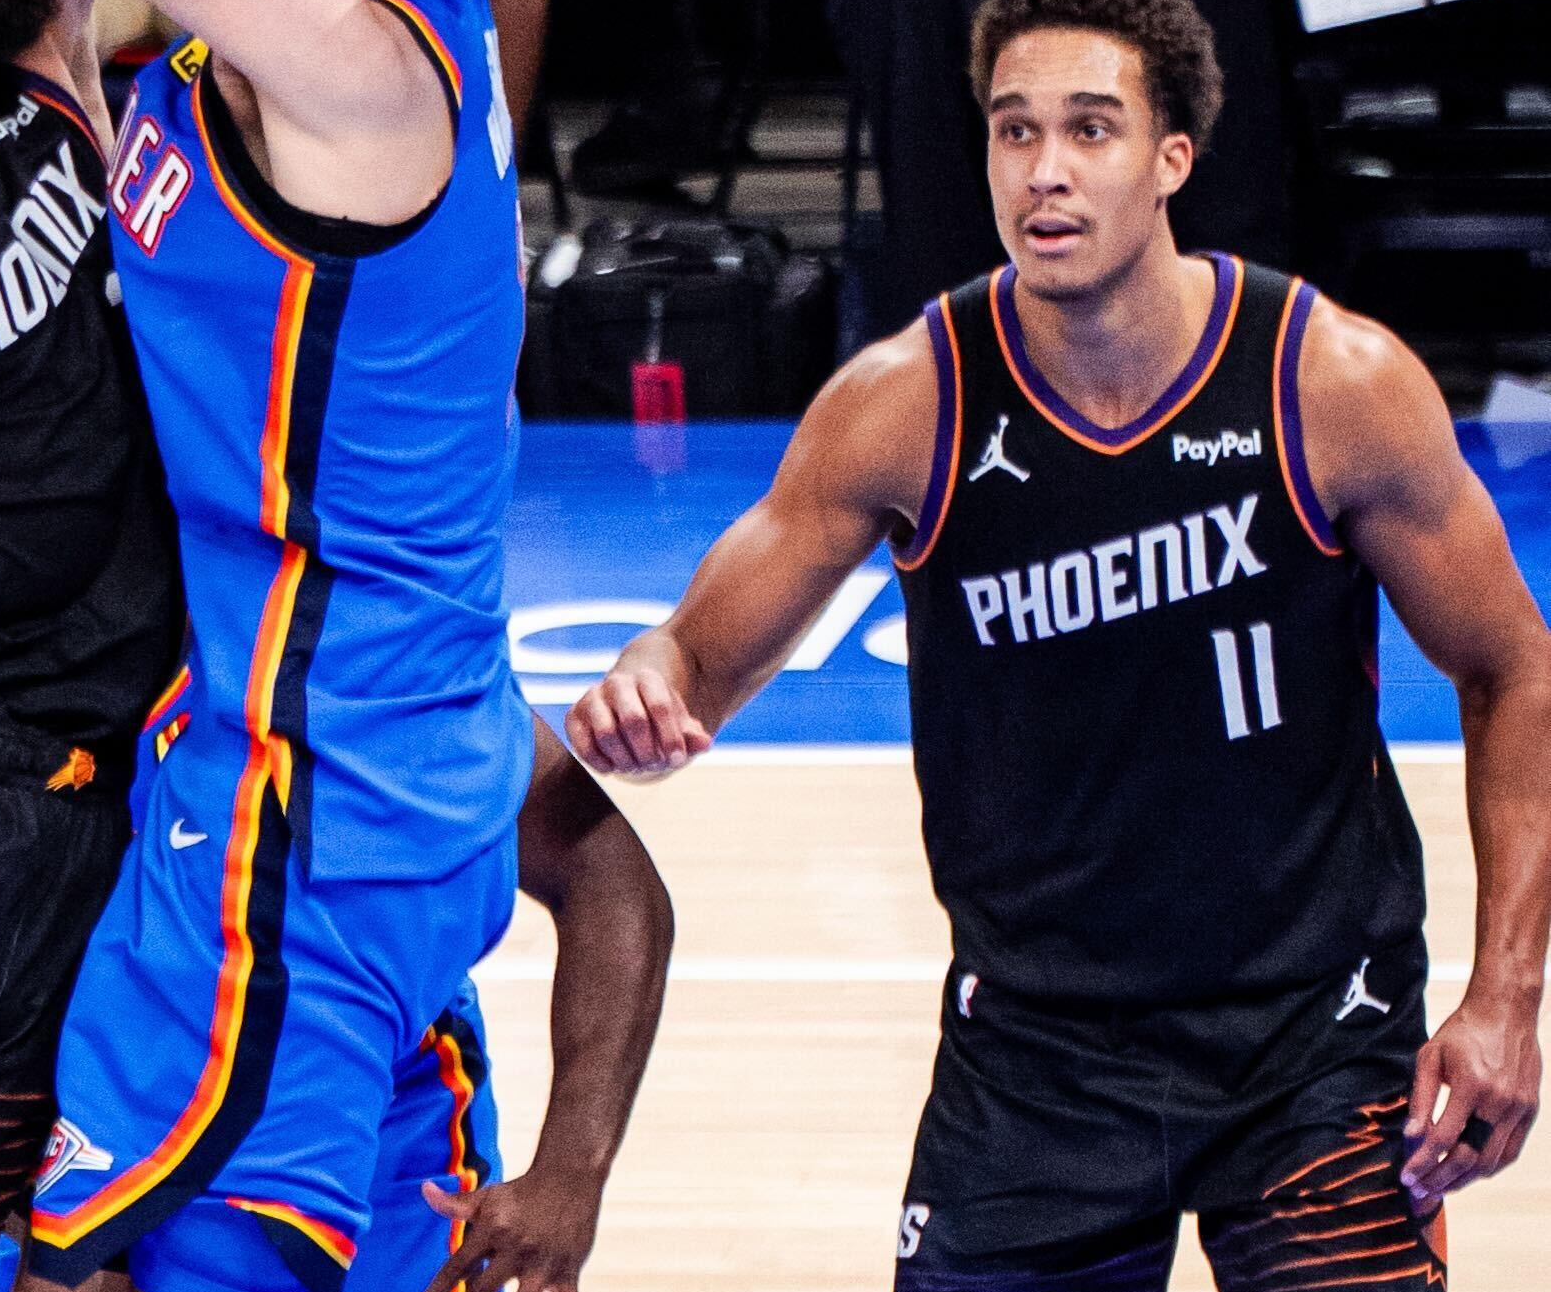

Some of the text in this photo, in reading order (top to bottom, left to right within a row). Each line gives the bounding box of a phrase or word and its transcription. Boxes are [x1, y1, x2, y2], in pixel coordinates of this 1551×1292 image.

[1172, 428, 1262, 467] PayPal
[960, 493, 1269, 646] PHOENIX
[1210, 621, 1283, 741] 11
